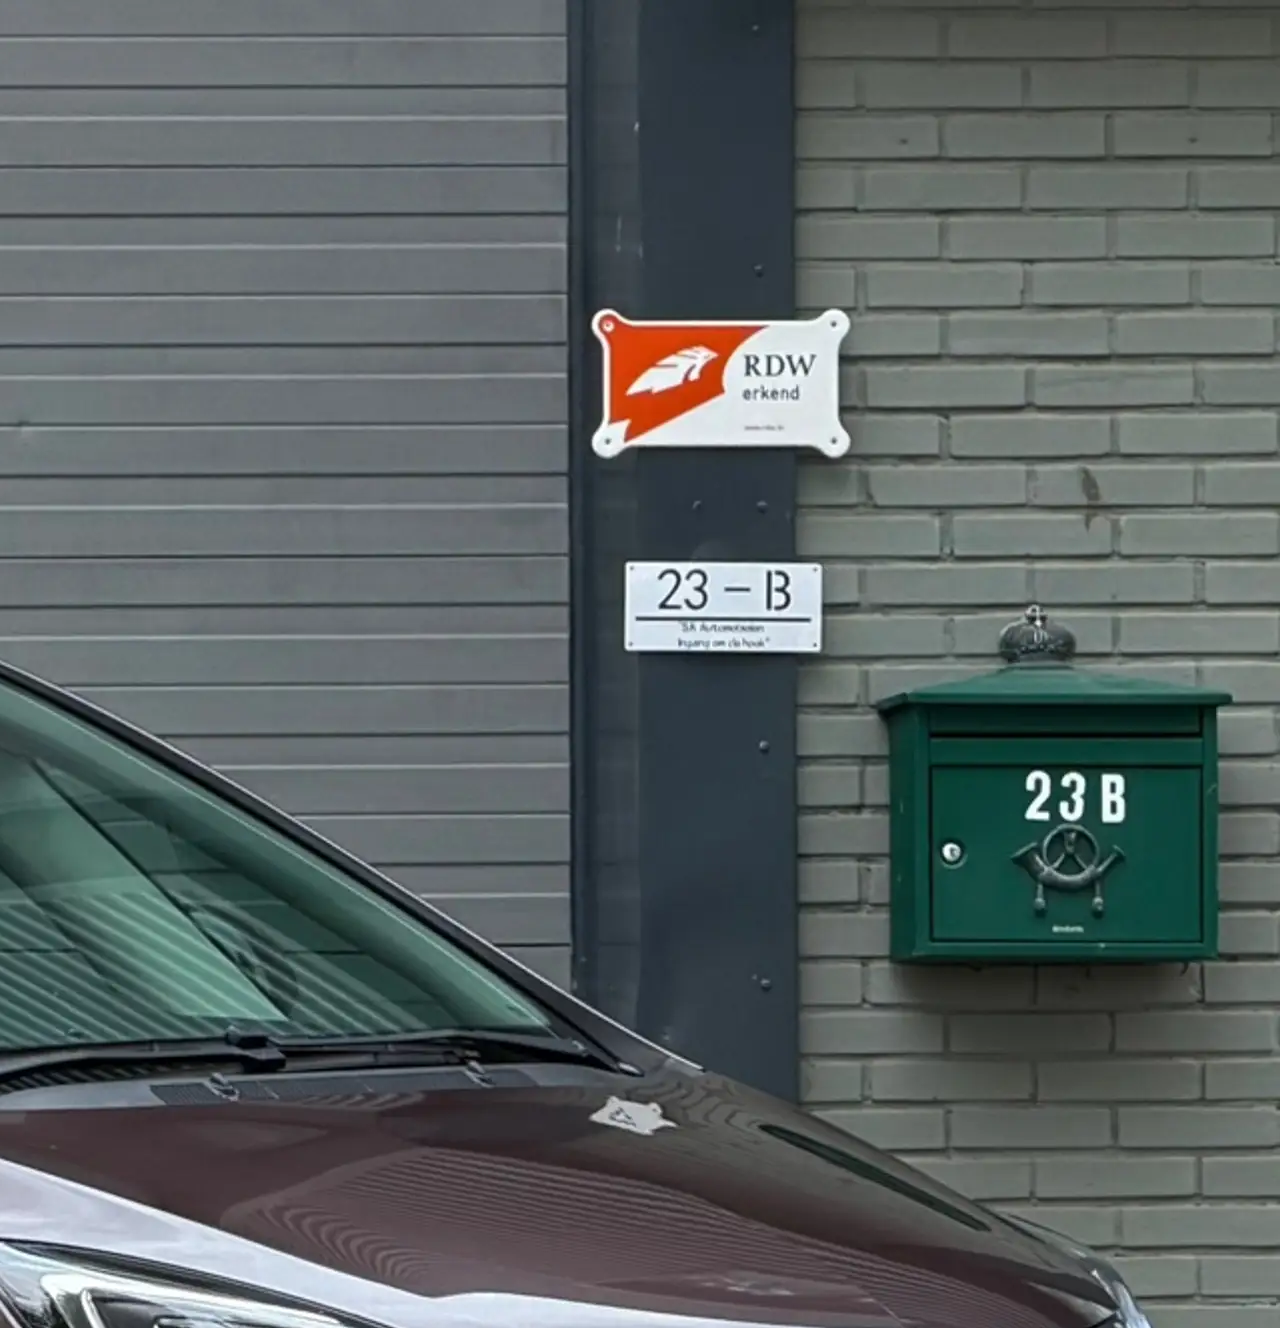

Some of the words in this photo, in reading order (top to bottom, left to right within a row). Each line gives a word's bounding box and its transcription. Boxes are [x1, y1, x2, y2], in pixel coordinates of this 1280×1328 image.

[743, 354, 816, 377] RDW
[742, 384, 800, 400] erkend
[657, 569, 708, 610] 23
[766, 570, 791, 611] B
[1024, 770, 1086, 822] 23
[1101, 773, 1126, 823] B
